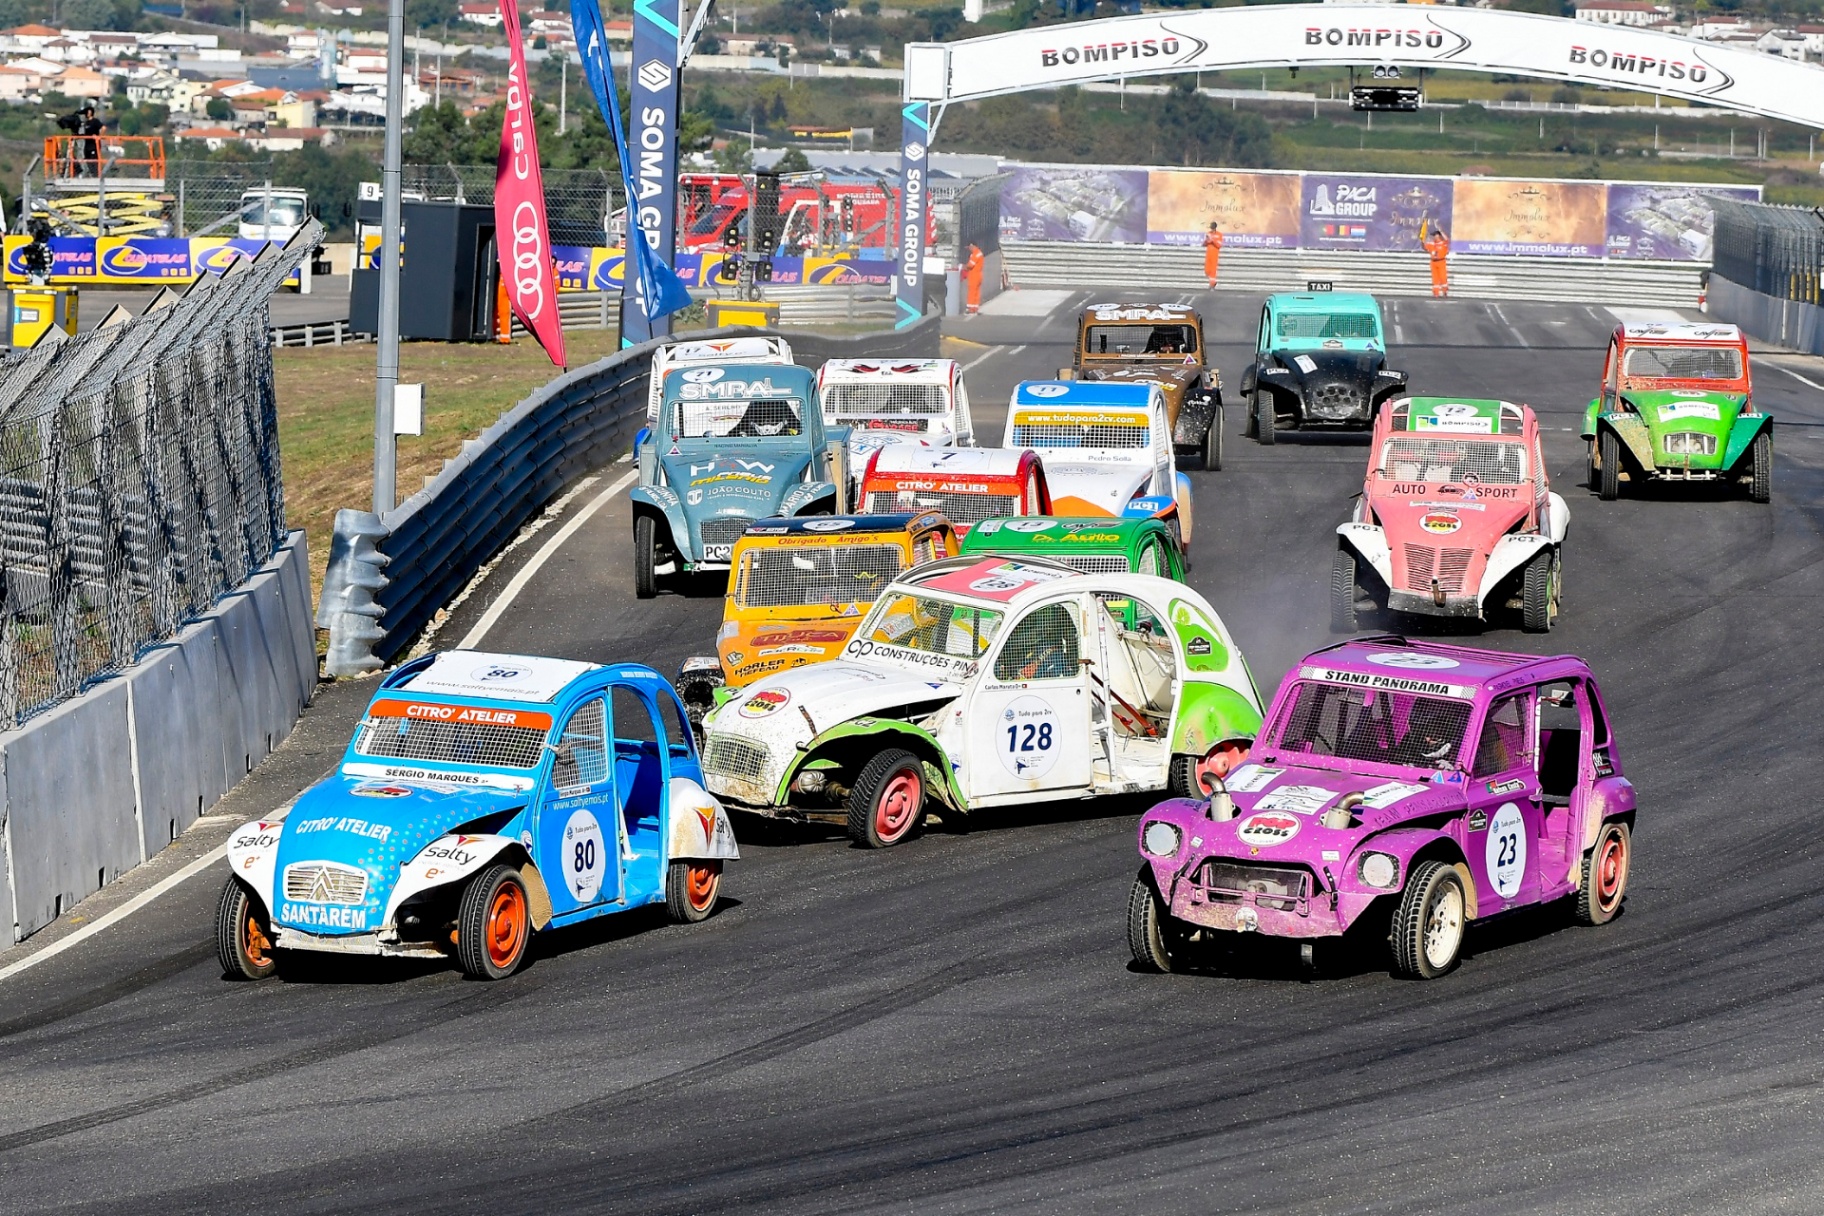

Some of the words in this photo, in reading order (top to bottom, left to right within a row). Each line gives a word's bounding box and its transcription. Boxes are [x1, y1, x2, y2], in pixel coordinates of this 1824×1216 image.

[639, 106, 665, 200] SOMA
[367, 185, 374, 197] 9
[905, 169, 921, 221] SOMA
[1336, 184, 1376, 202] PACA
[1336, 202, 1377, 217] GROUP
[904, 224, 919, 287] GROUP
[1469, 242, 1588, 255] www.immolux.pt
[1310, 283, 1331, 291] TAXI
[1028, 413, 1135, 424] www.tudopara2cv.com
[735, 486, 771, 497] COUTO
[940, 482, 988, 493] ATELIER
[1393, 484, 1426, 494] AUTO
[1476, 487, 1517, 498] SPORT
[778, 536, 827, 545] Obrigado
[874, 645, 950, 668] CONSTRUÇÕES
[487, 669, 518, 678] 80
[1325, 670, 1370, 684] STAND
[1372, 674, 1449, 695] PANORAMA
[458, 709, 517, 724] ATELIER
[1007, 722, 1053, 753] 128
[427, 772, 479, 783] MARQUES
[336, 818, 392, 841] ATELIER
[1248, 817, 1297, 830] POP
[1243, 827, 1290, 837] CROSS
[574, 838, 595, 872] 80
[1497, 833, 1516, 868] 23
[281, 903, 367, 929] SANTARÉM
